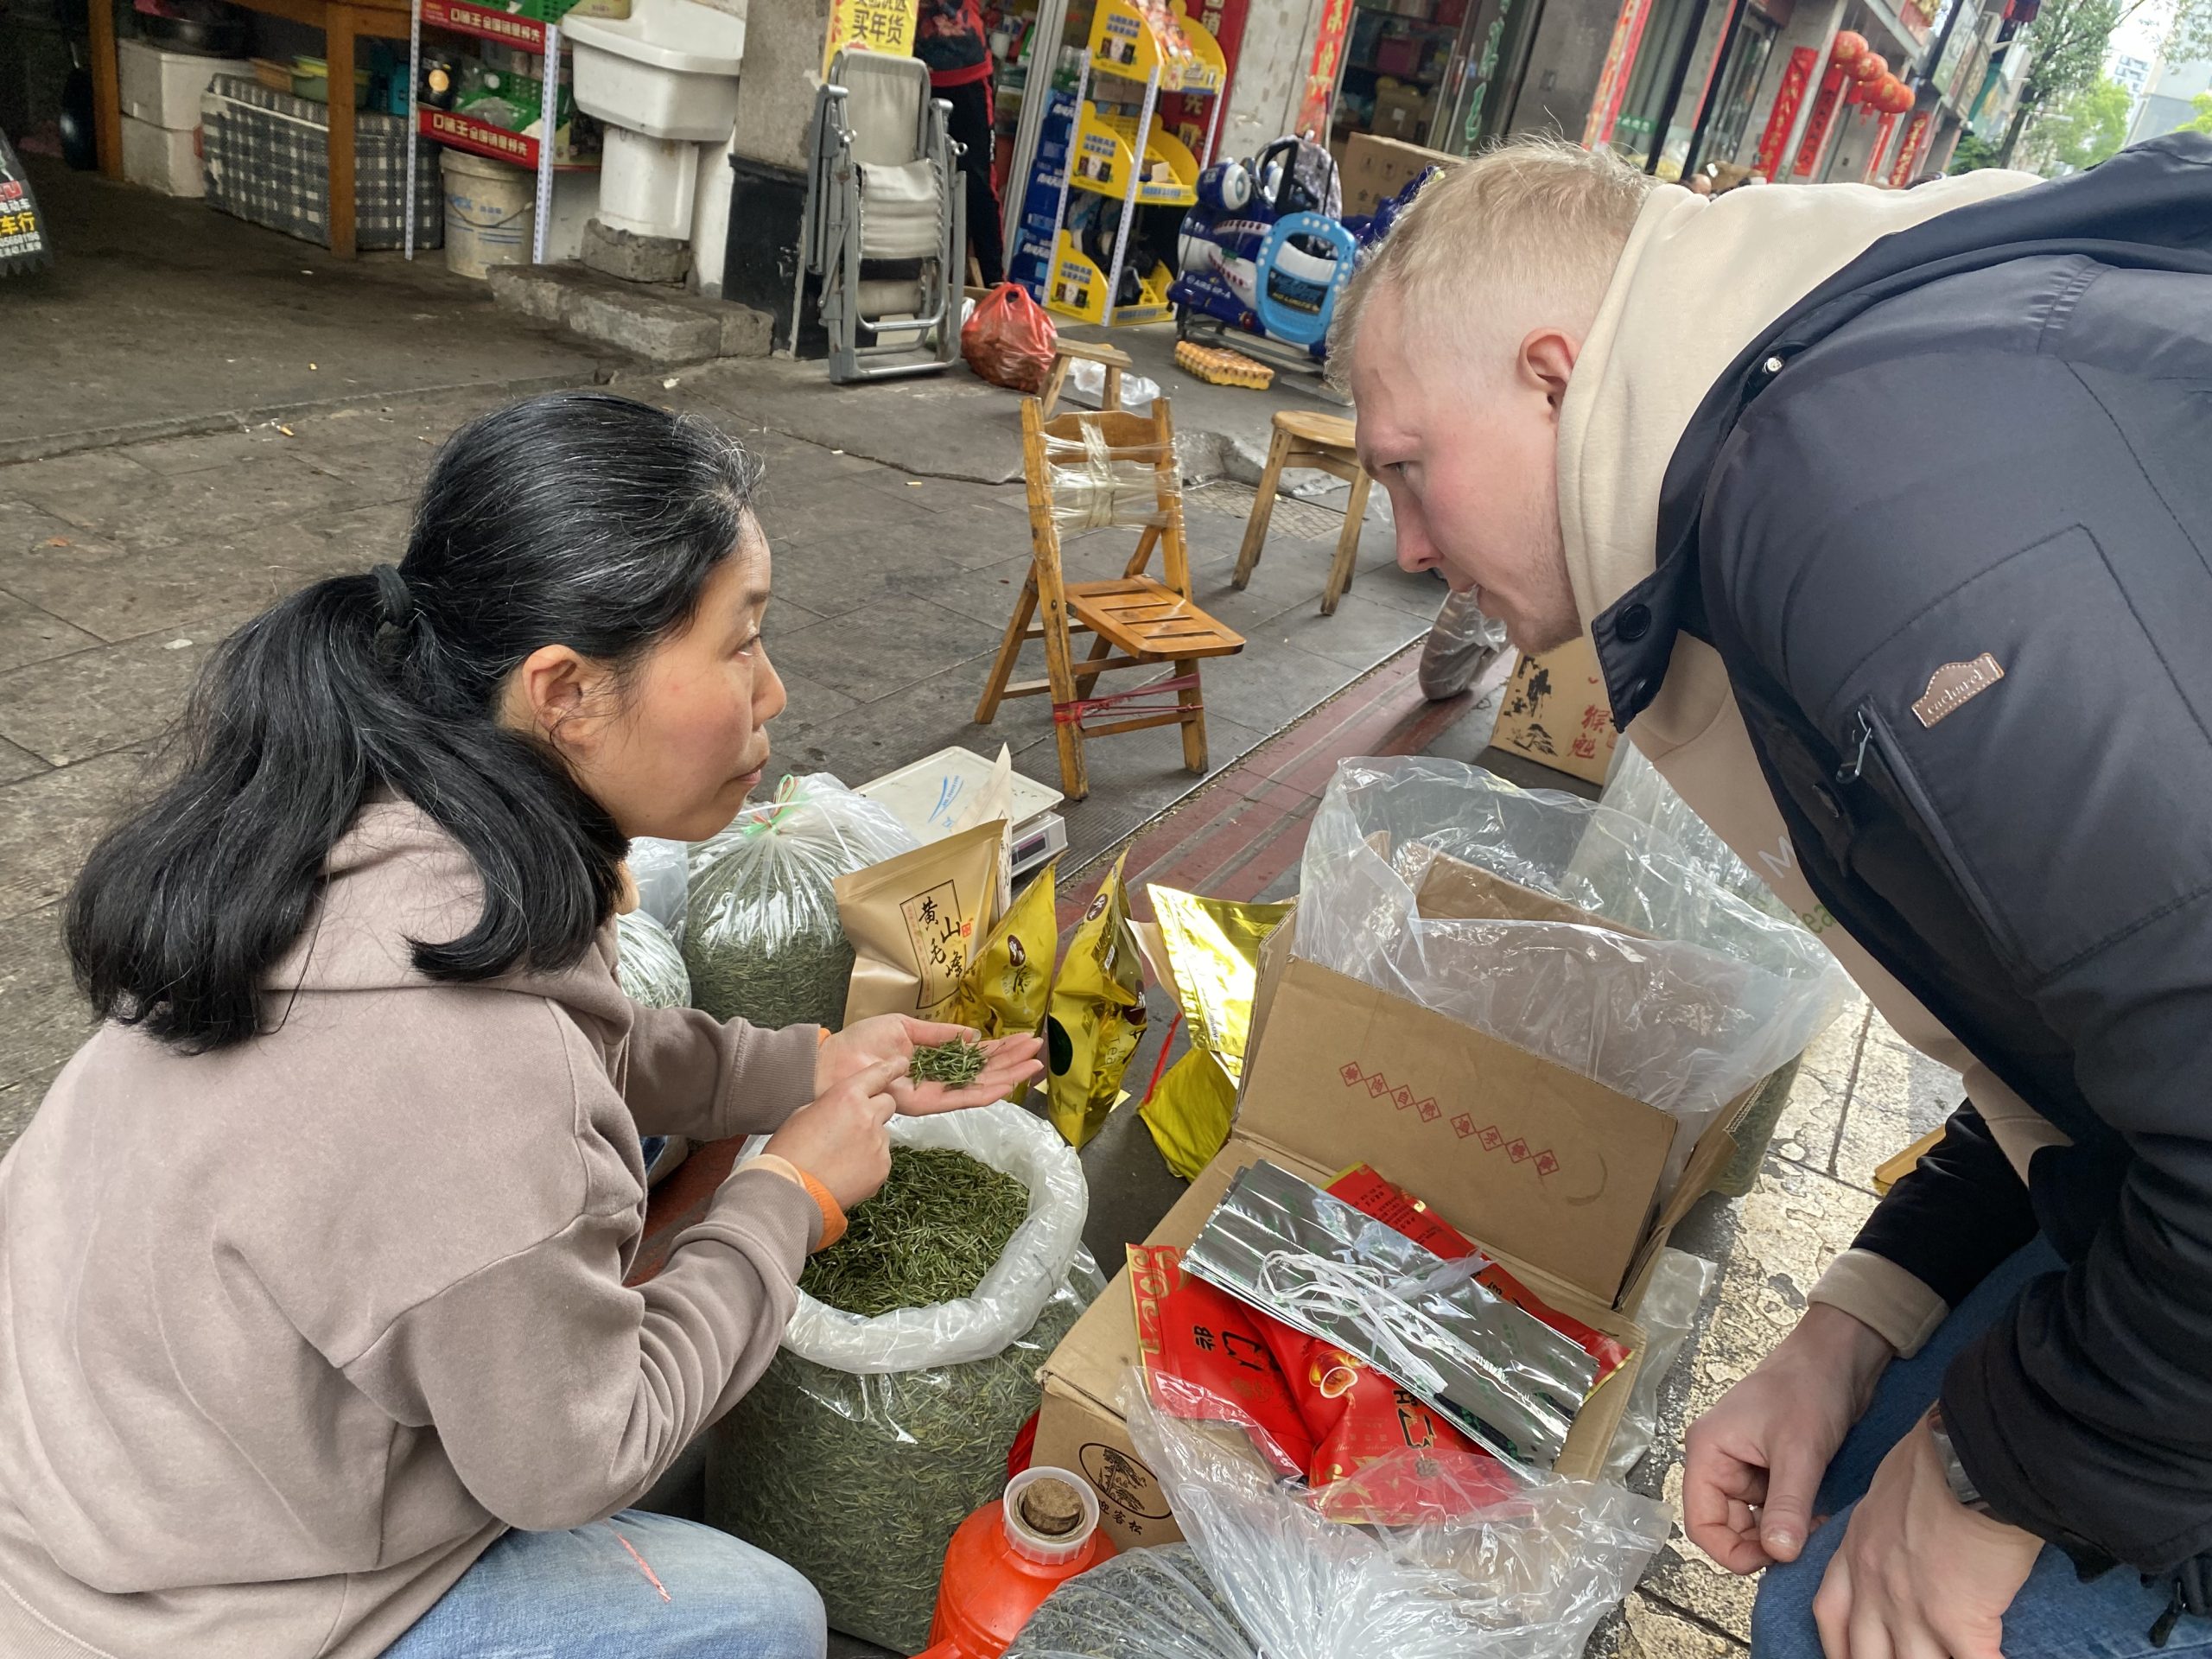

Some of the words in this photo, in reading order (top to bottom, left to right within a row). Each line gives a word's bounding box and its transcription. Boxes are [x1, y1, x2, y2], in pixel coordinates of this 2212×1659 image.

[851, 9, 904, 44] 买年货
[918, 897, 963, 978] 黄山毛峰
[1098, 1499, 1142, 1535] 迎客松
